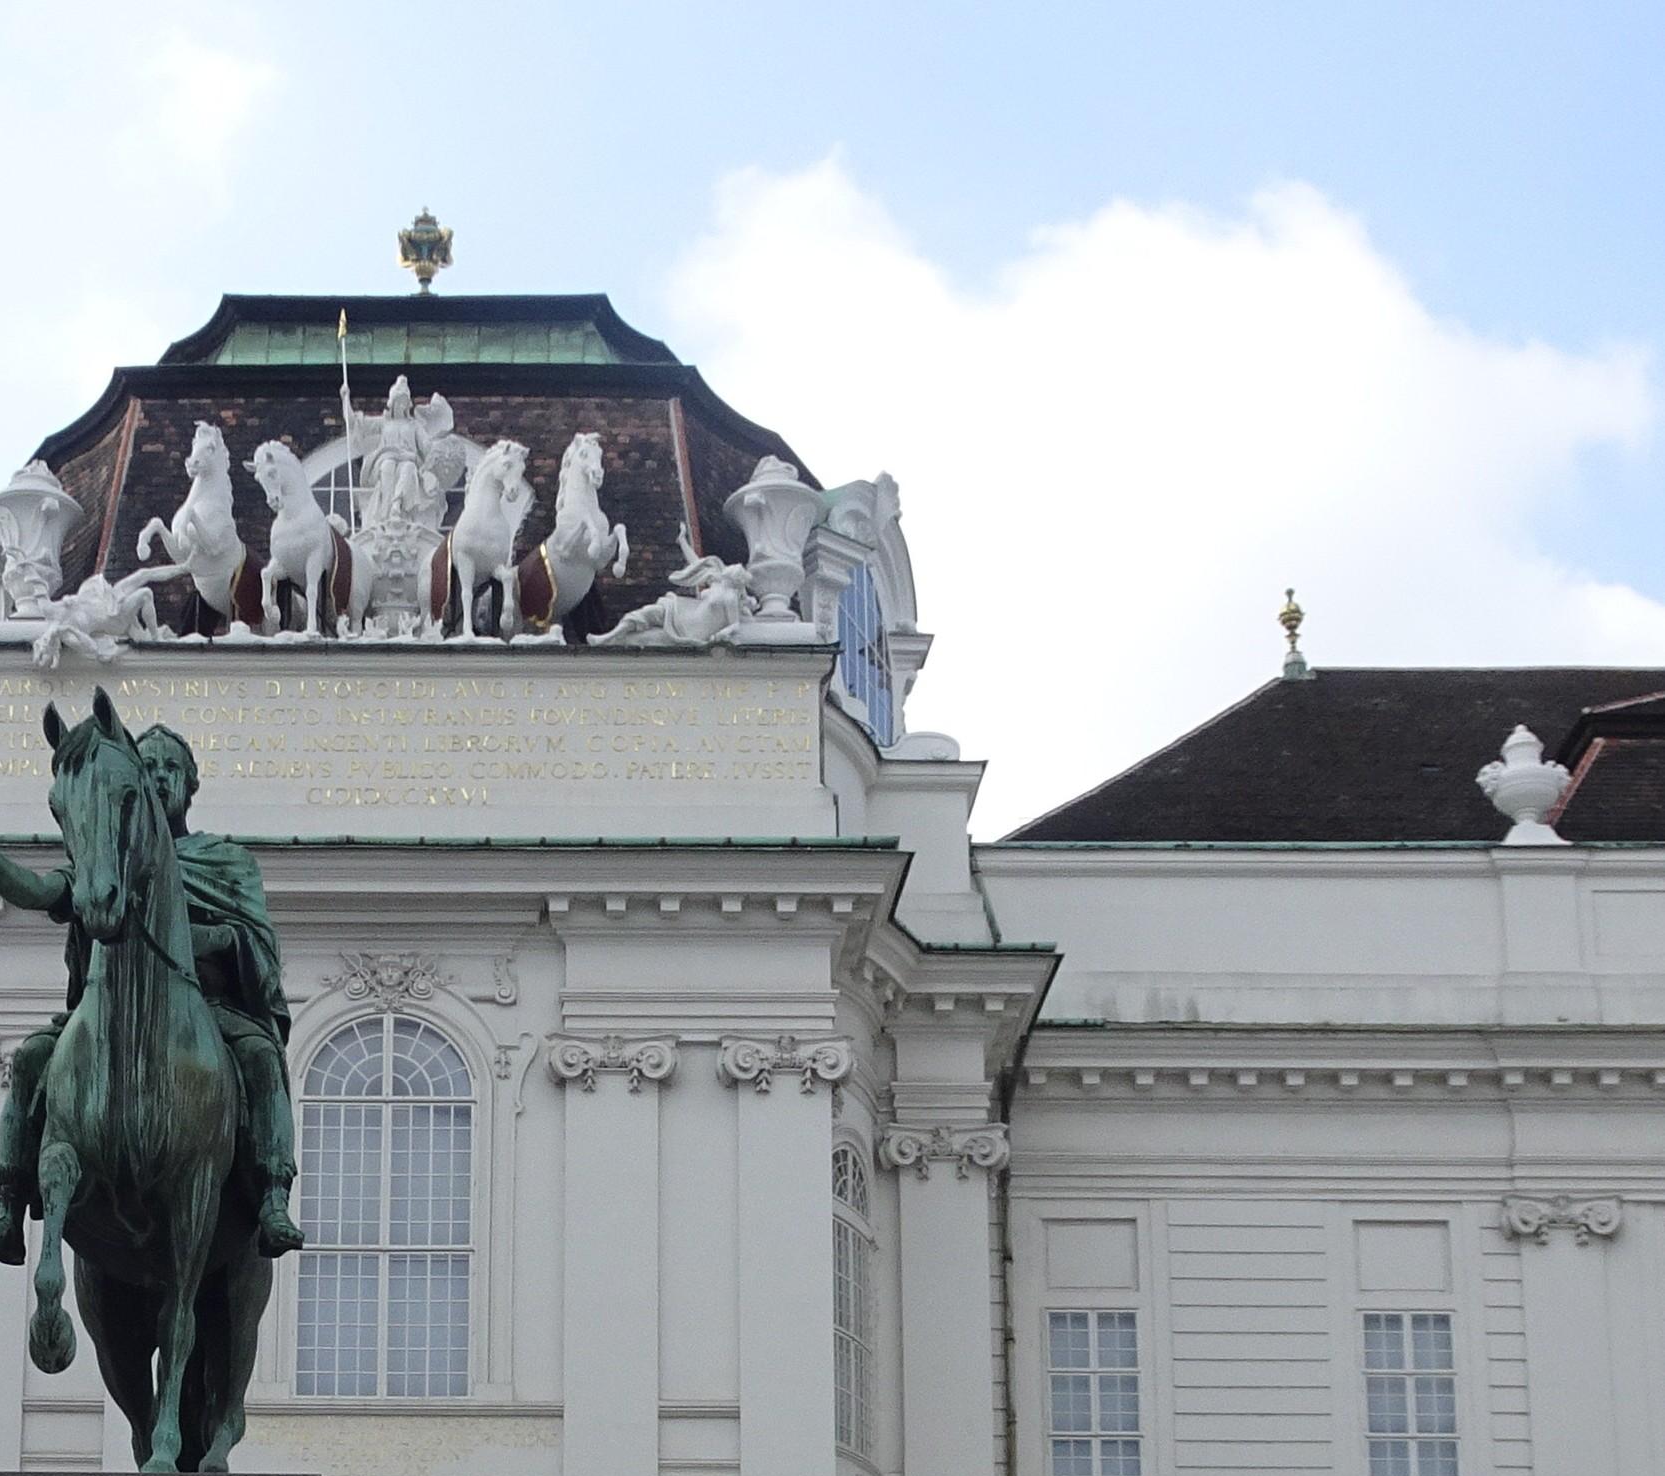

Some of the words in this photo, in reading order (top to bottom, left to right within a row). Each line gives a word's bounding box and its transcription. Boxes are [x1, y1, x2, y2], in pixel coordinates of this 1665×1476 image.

[117, 679, 247, 698] AVSTRIVS
[182, 707, 322, 725] CONFECTO
[470, 762, 609, 780] COMMODO
[626, 762, 716, 780] PATERE
